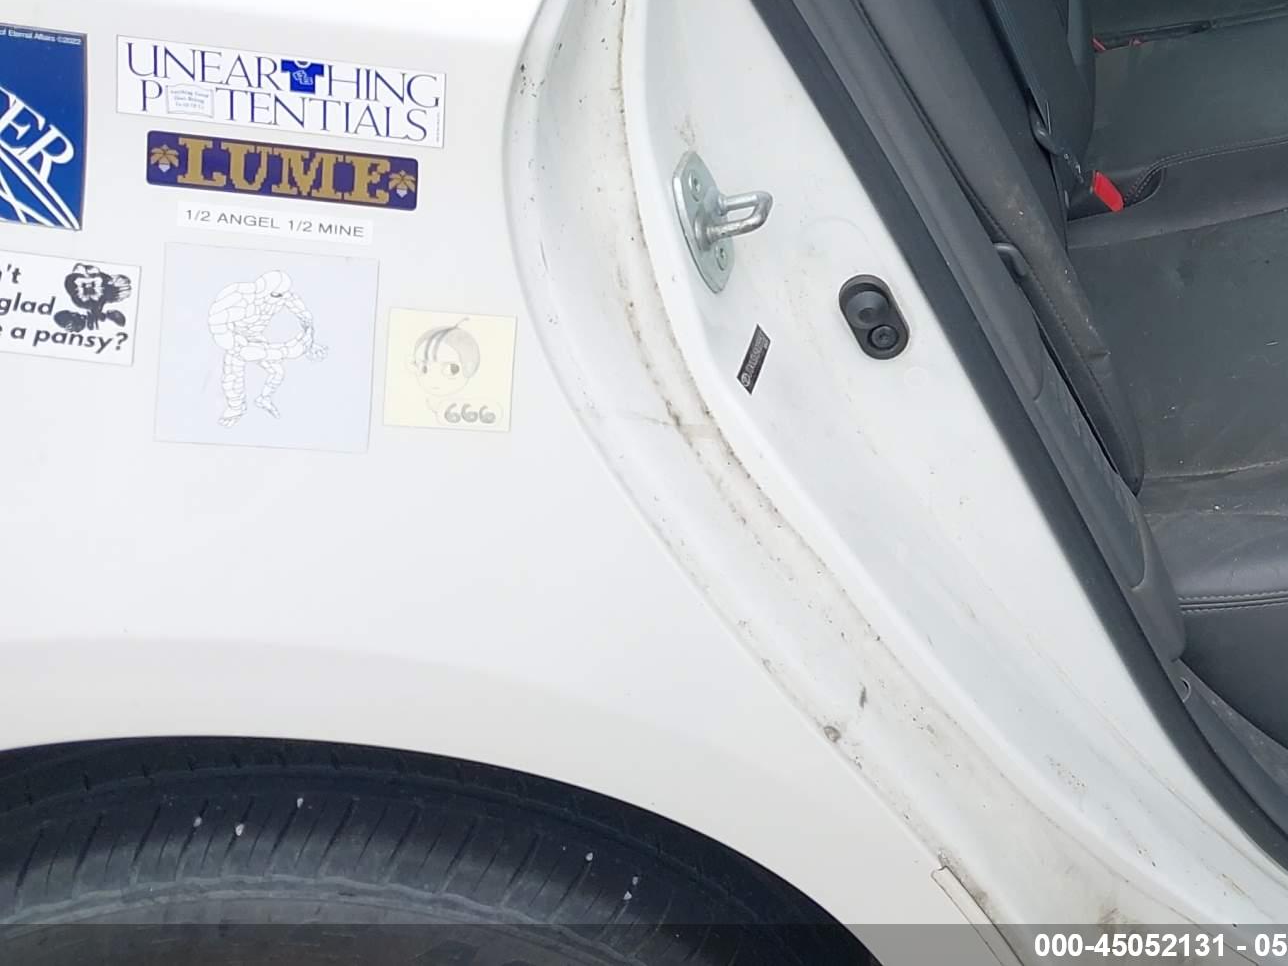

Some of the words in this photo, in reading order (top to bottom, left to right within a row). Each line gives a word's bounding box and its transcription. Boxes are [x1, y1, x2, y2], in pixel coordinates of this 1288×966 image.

[127, 42, 439, 108] UNEARHING
[141, 79, 427, 141] PTENTIALS
[177, 137, 391, 204] LUME
[185, 209, 211, 222] 1/2
[217, 212, 280, 229] ANGEL
[288, 219, 312, 232] 1/2
[318, 222, 364, 238] MINE
[0, 264, 21, 284] 't
[0, 292, 56, 315] glad
[10, 327, 27, 339] a
[32, 330, 128, 354] pansy?
[444, 402, 496, 424] 666
